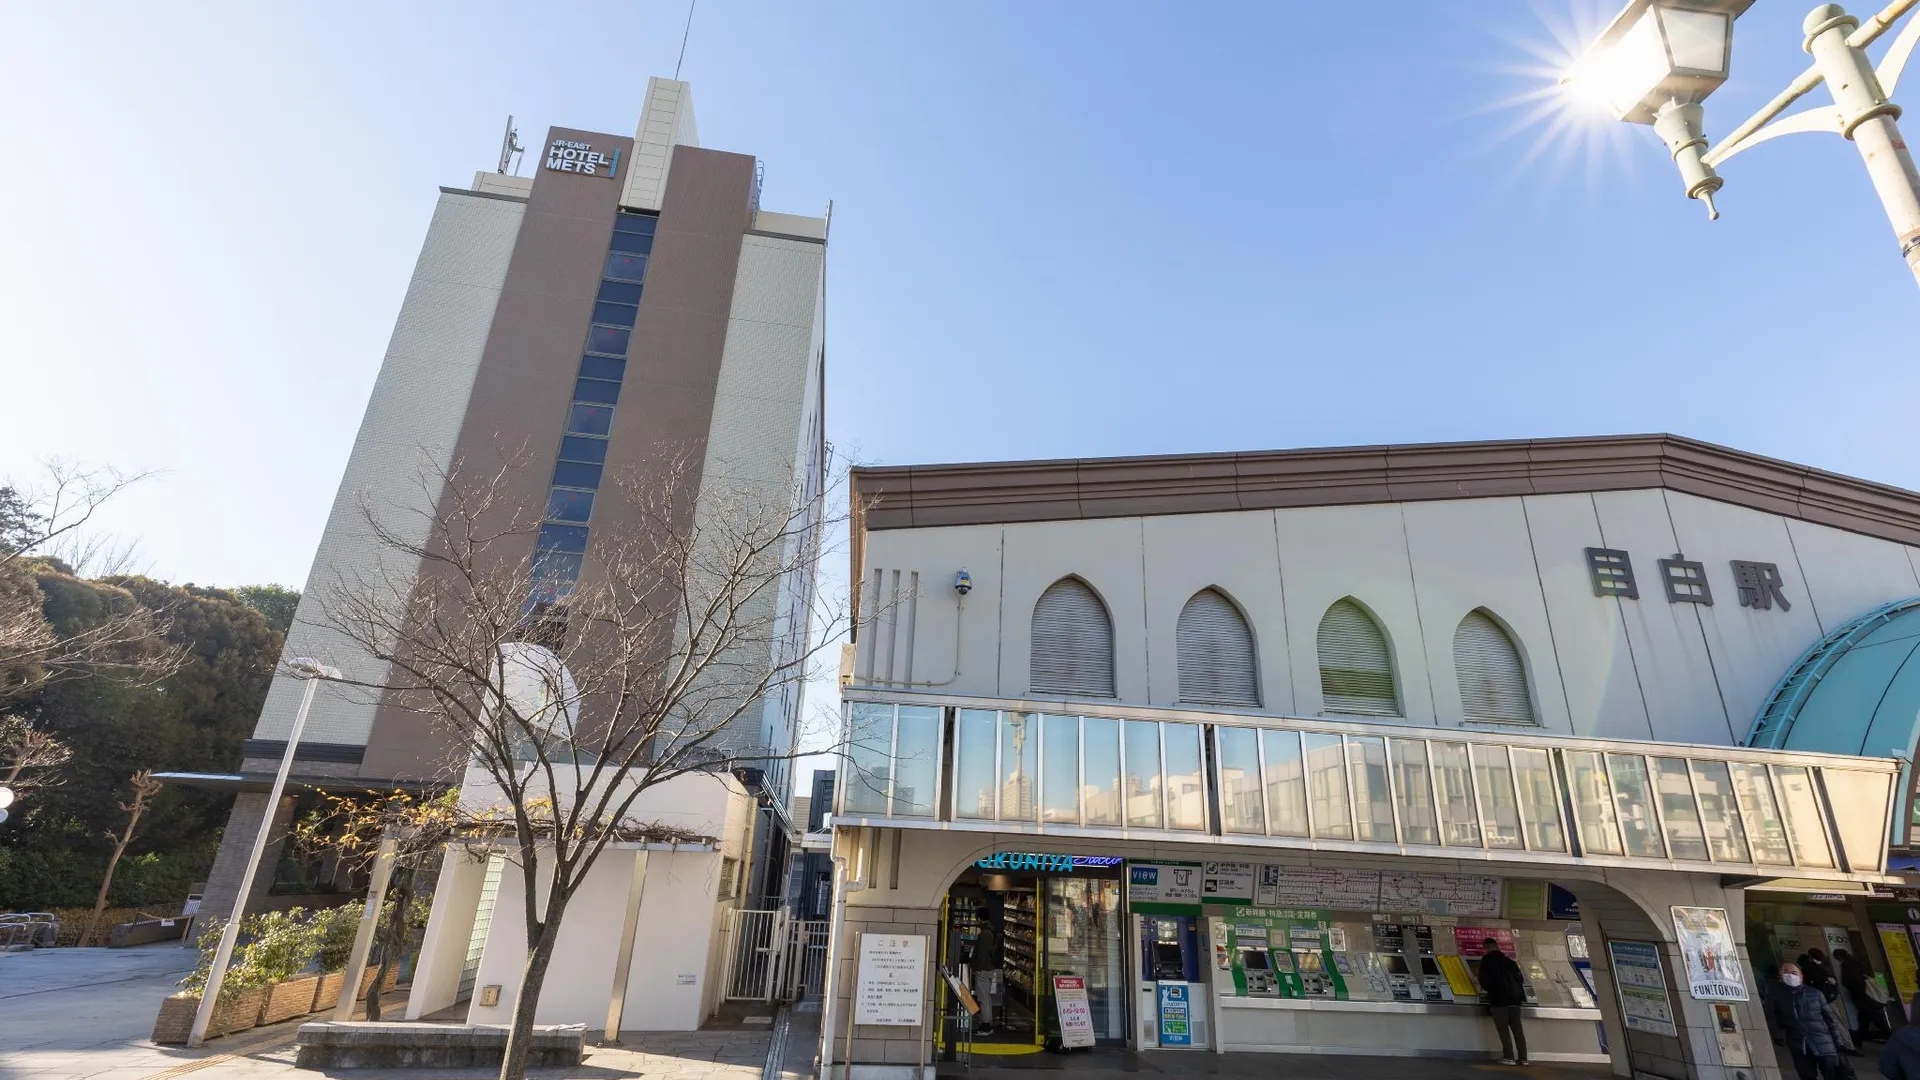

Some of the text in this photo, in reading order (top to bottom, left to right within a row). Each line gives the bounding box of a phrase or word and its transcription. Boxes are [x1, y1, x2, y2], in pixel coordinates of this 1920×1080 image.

[552, 140, 591, 150] JR-EAST
[549, 146, 609, 165] HOTEL
[545, 157, 596, 175] METS
[1583, 546, 1792, 613] 目白駅
[972, 852, 1074, 872] OKUNIYA
